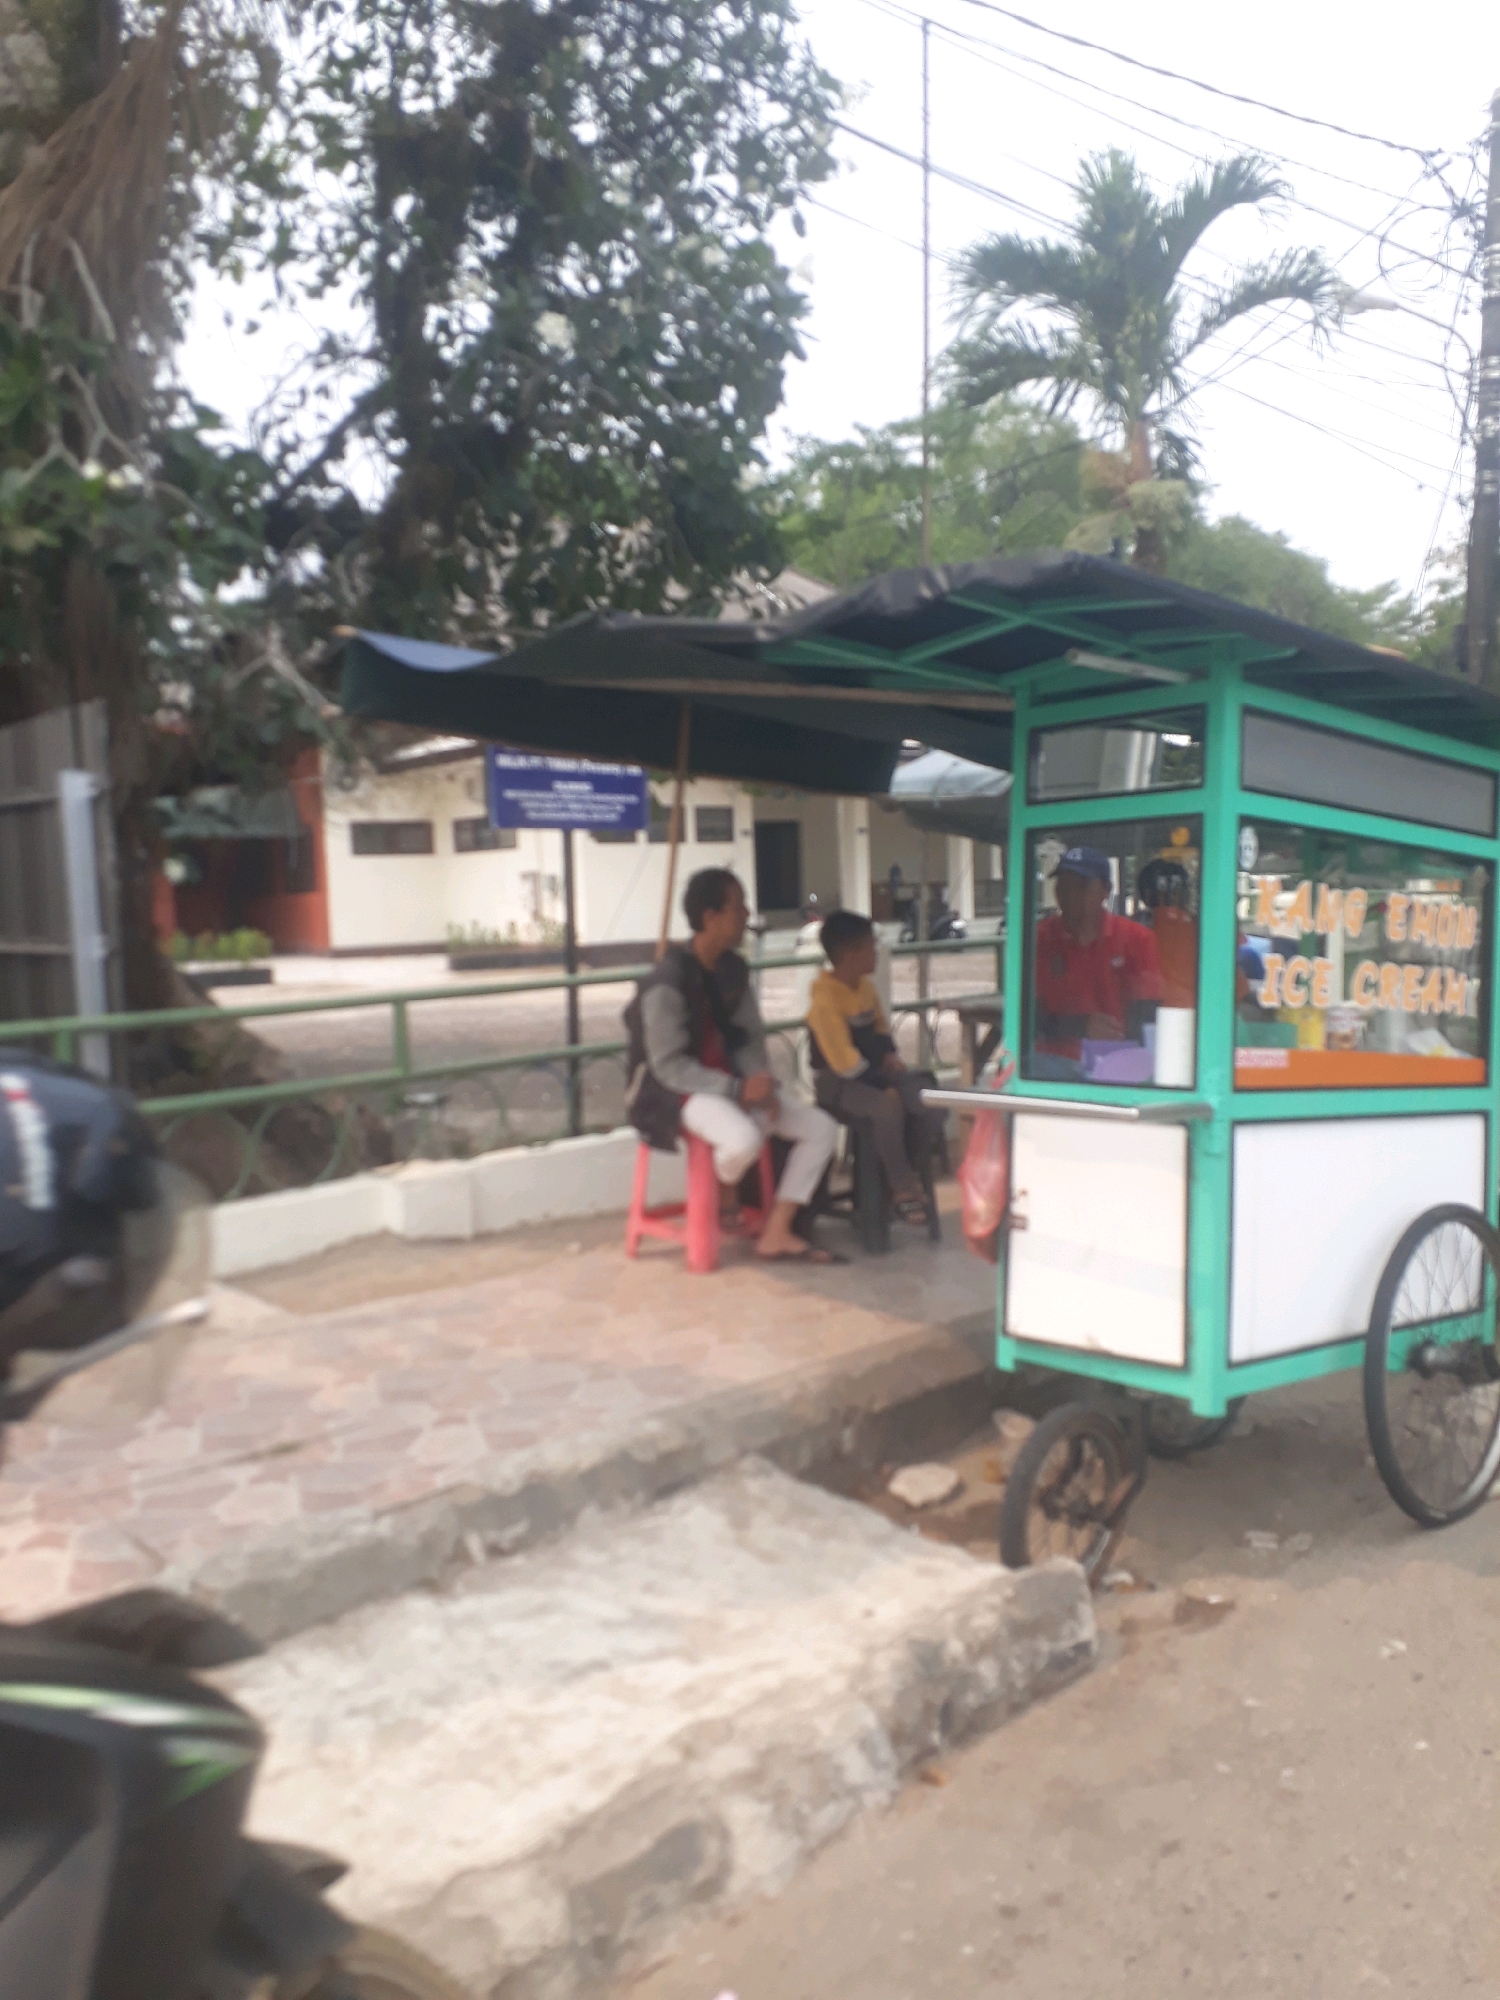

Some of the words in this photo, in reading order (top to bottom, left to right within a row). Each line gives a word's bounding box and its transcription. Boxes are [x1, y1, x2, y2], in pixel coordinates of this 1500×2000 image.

[1256, 879, 1368, 937] KANG
[1386, 892, 1478, 949] EMON
[1258, 953, 1334, 1008] ICE
[1353, 960, 1468, 1016] CREAM
